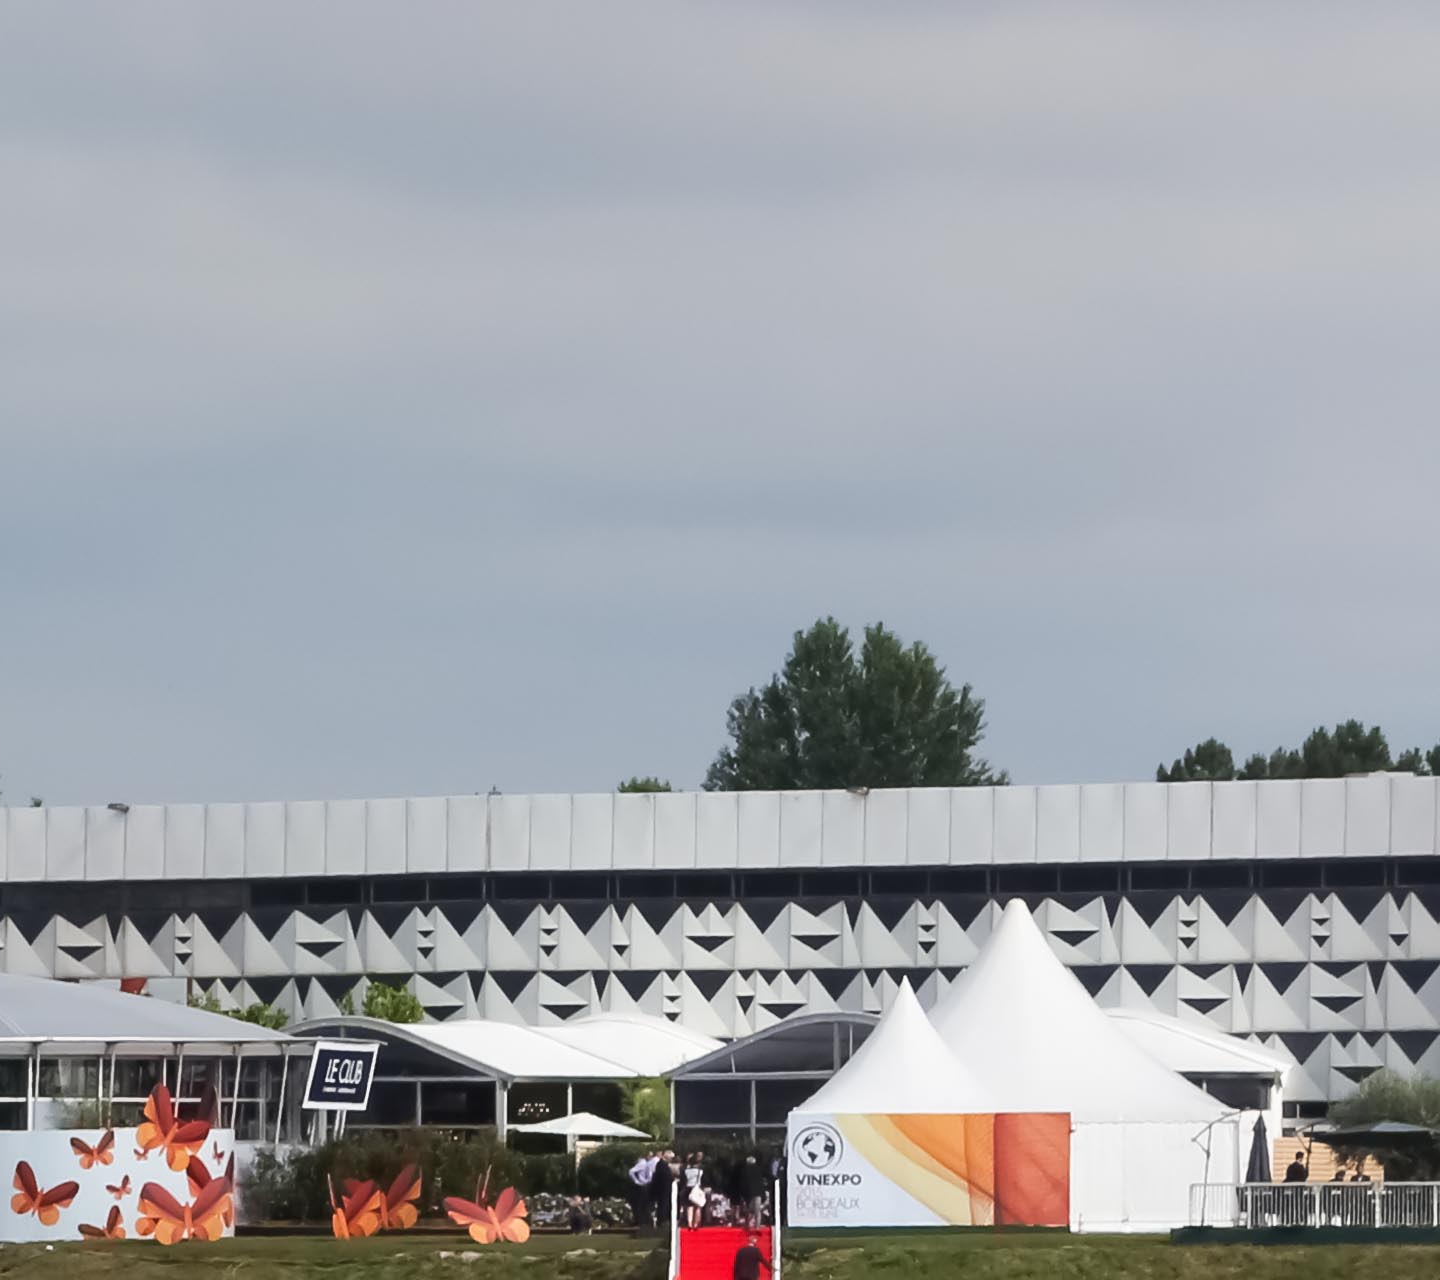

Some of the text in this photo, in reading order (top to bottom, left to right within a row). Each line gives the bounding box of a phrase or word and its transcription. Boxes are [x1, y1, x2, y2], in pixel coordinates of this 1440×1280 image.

[325, 1058, 363, 1084] LE CLUB
[796, 1174, 862, 1186] VINEXPO
[796, 1198, 861, 1210] BORDEAUX
